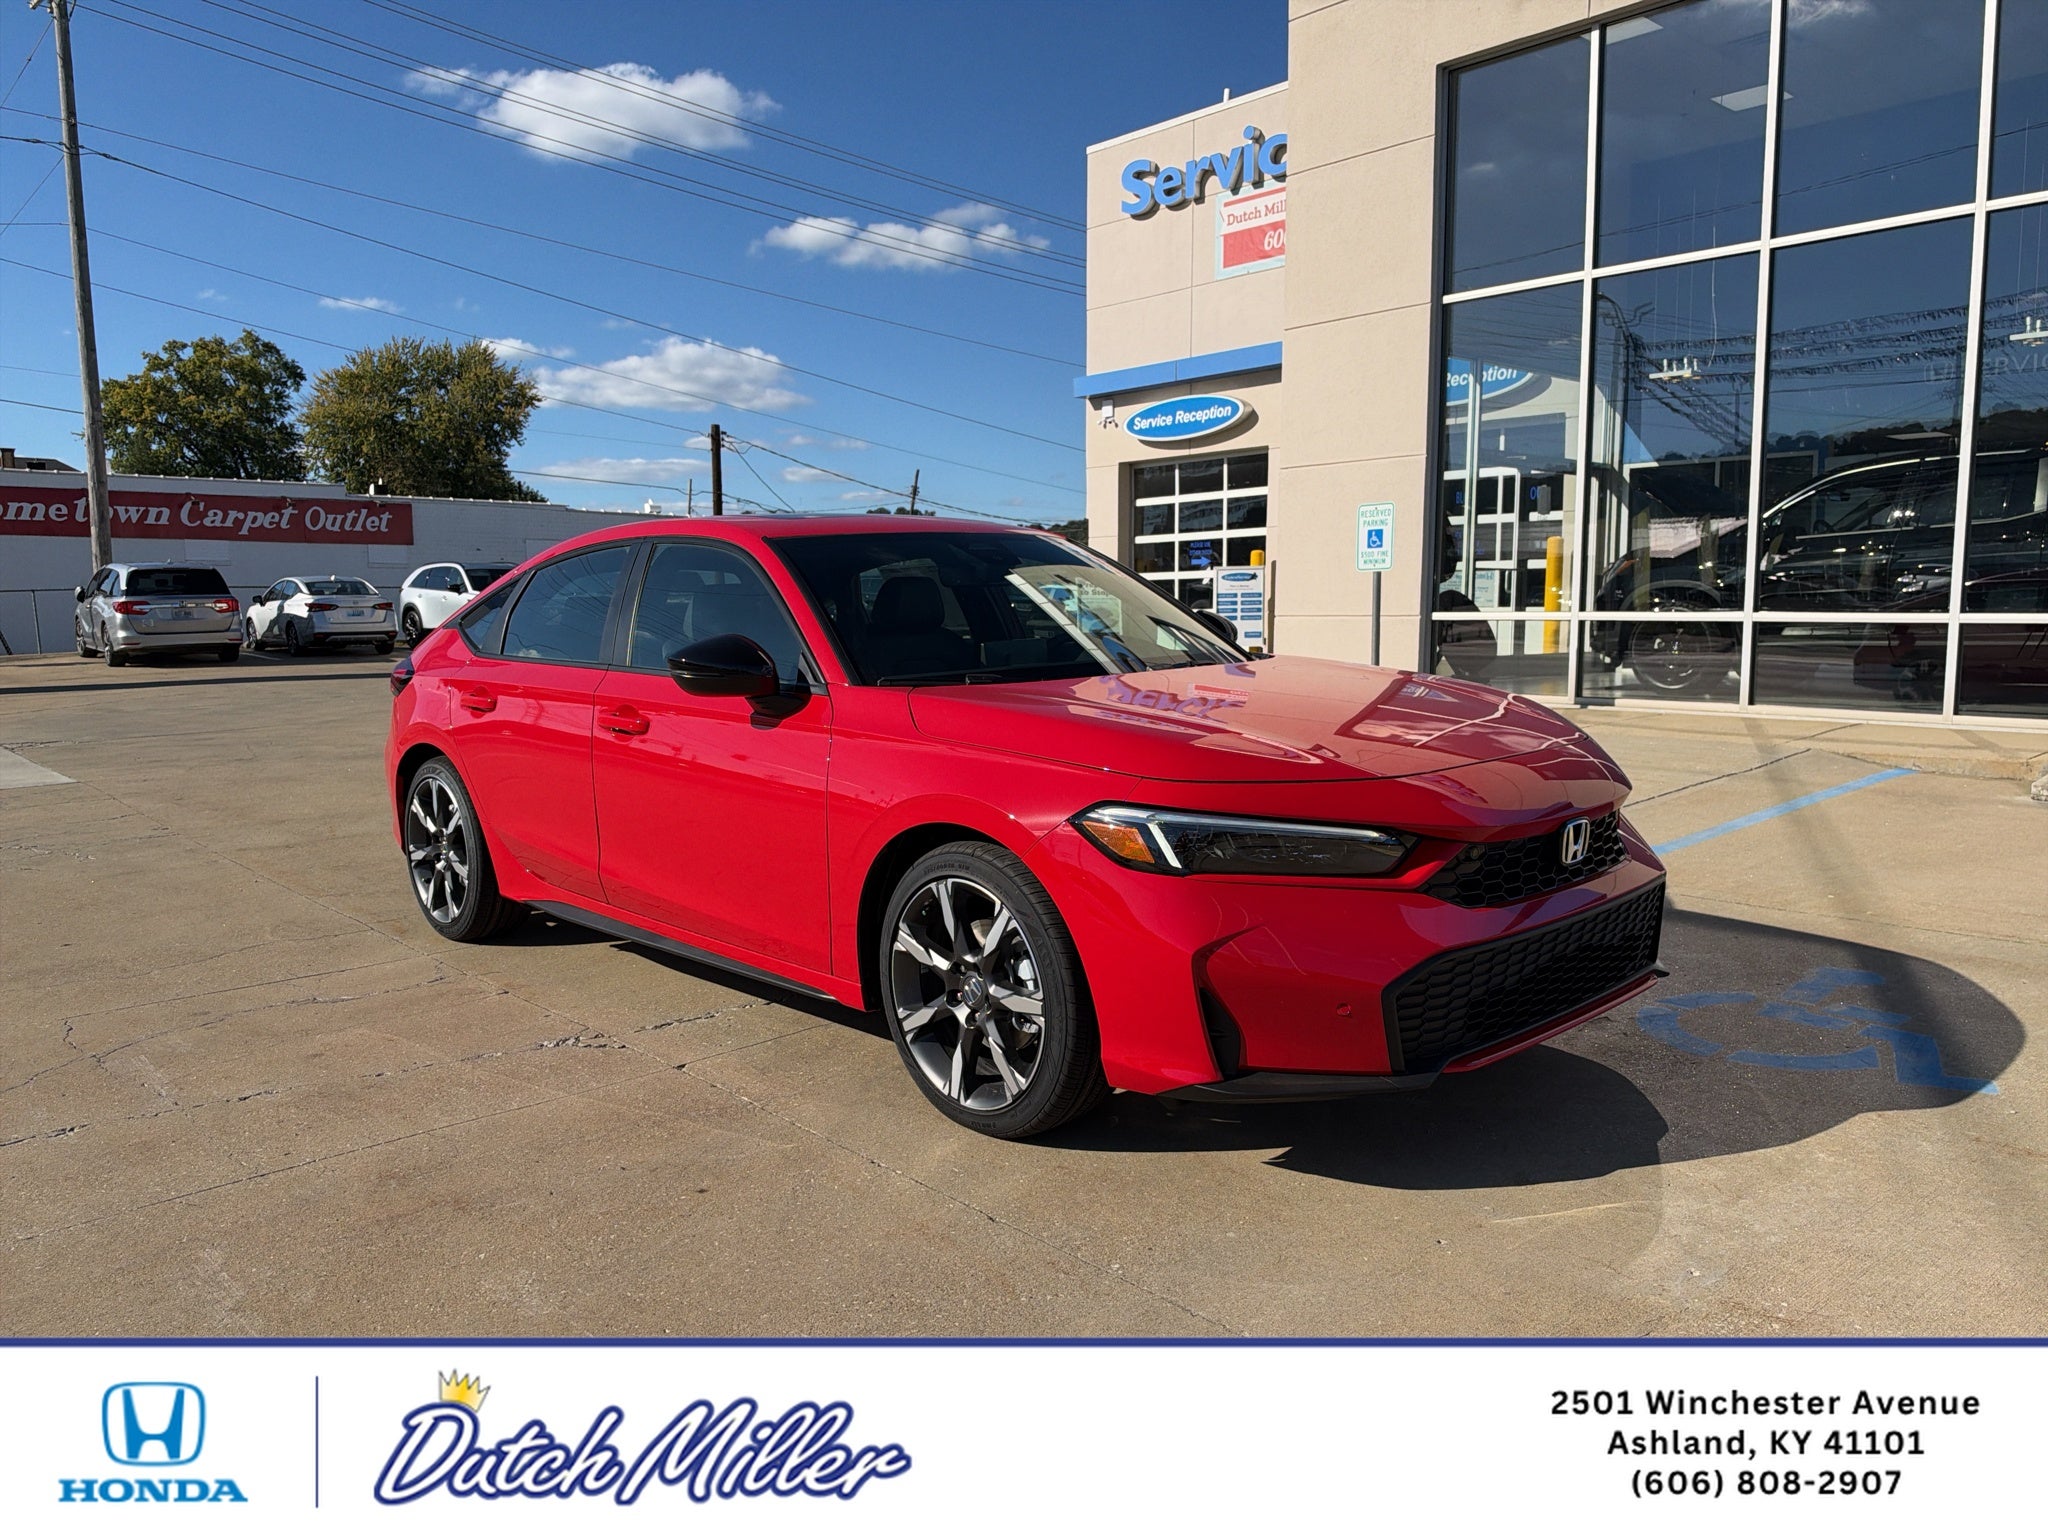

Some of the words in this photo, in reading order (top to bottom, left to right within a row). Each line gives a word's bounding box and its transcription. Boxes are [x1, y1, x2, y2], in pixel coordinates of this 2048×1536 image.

[1226, 206, 1262, 227] Dutch
[1264, 228, 1287, 252] 60
[1132, 413, 1174, 431] Service
[1175, 404, 1232, 424] Reception
[179, 500, 299, 536] Carpet
[304, 505, 393, 533] Outlet
[1360, 508, 1392, 519] RESERVED
[1362, 518, 1389, 528] PARKING
